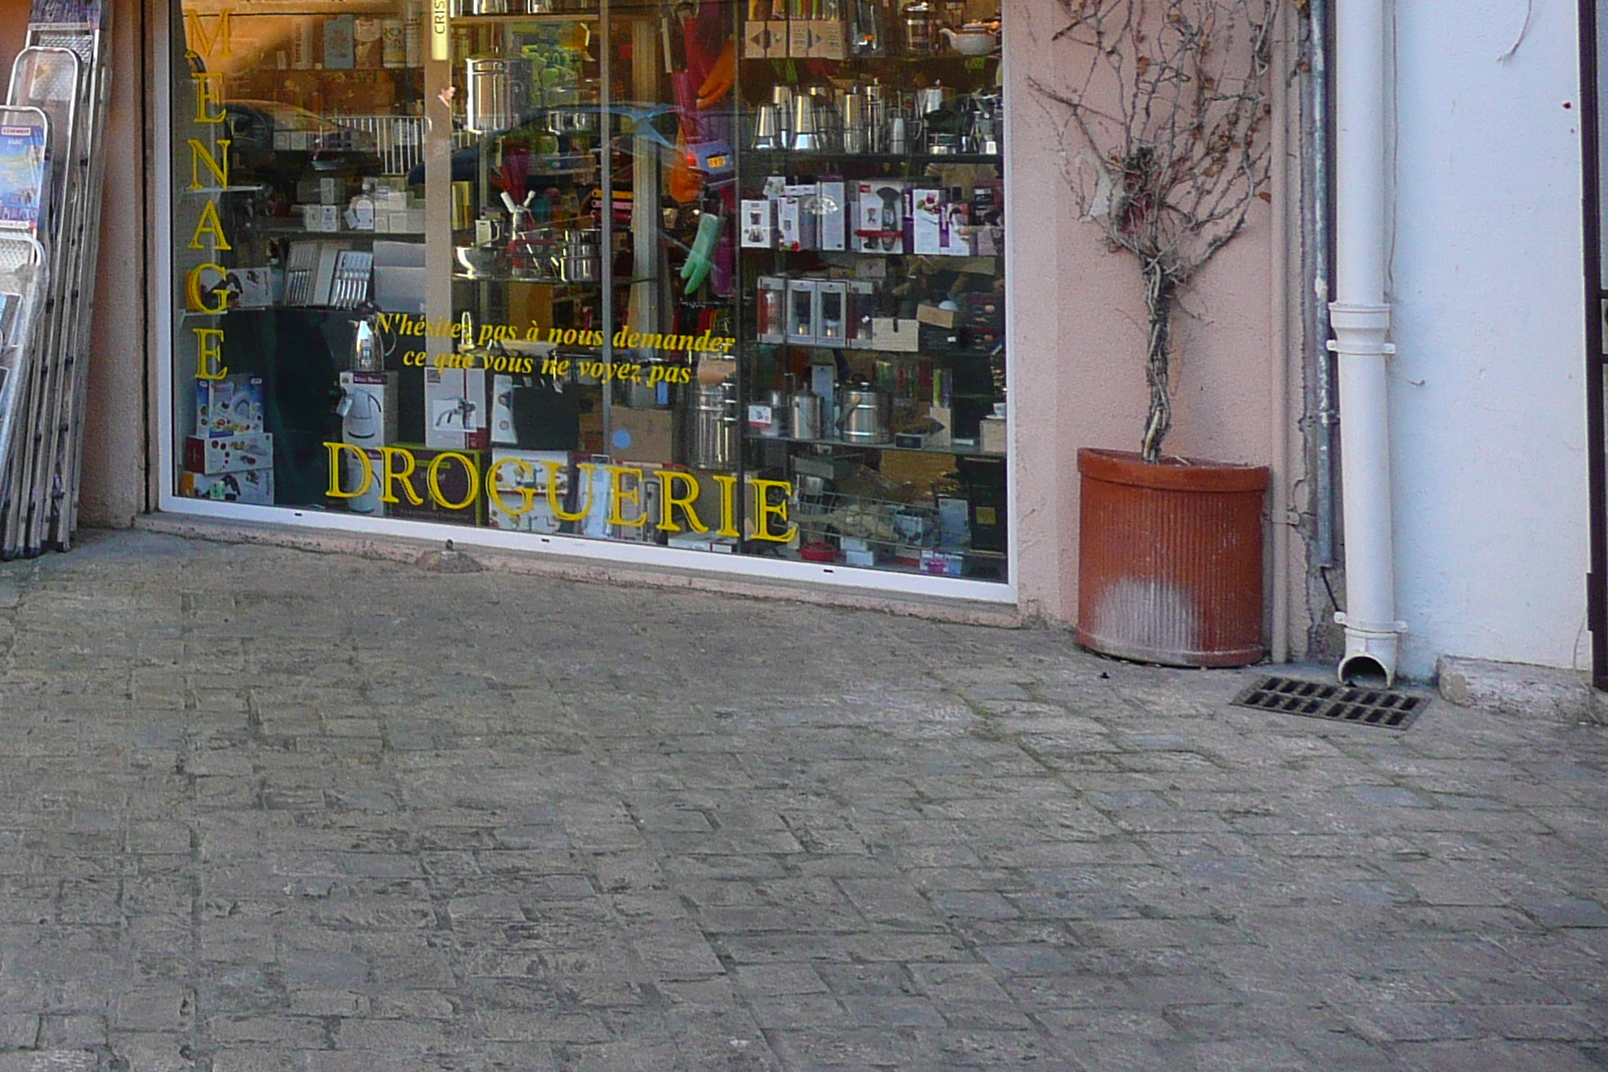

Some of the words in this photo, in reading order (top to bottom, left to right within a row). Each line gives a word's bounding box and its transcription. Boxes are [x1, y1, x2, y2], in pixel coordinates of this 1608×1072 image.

[477, 323, 518, 347] pas
[525, 319, 540, 342] à
[547, 327, 605, 347] nous
[612, 325, 736, 354] demander
[403, 351, 426, 367] ce
[434, 352, 476, 374] que
[482, 355, 534, 374] vous
[541, 357, 570, 377] ne
[577, 360, 642, 385] voyez
[646, 364, 692, 388] pas
[322, 441, 798, 544] DROGUERIE
